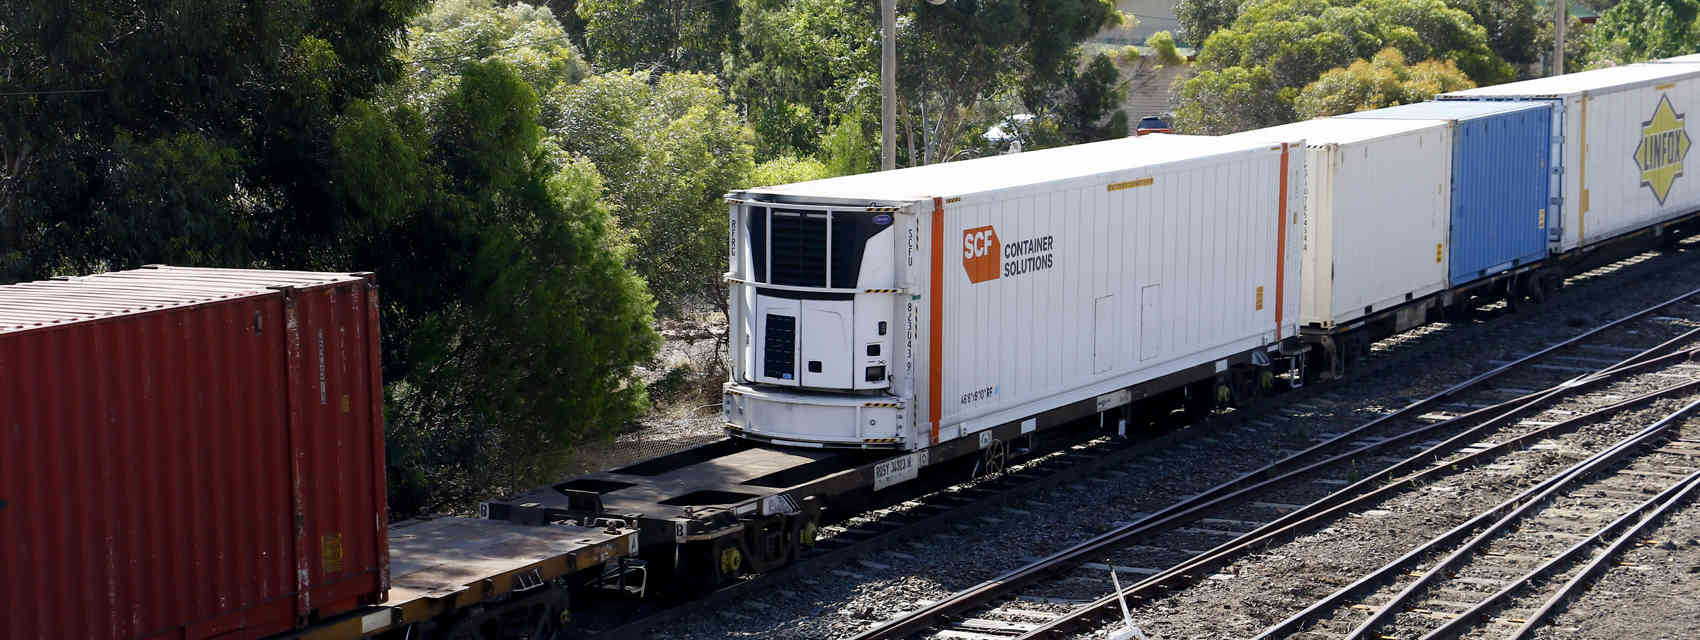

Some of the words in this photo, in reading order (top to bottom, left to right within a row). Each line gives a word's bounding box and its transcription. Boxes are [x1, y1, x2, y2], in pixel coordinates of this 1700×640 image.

[1644, 129, 1682, 171] LINFOX
[964, 230, 993, 259] SCF
[1004, 235, 1054, 259] CONTAINER
[1004, 254, 1053, 277] SOLUTIONS
[676, 523, 684, 537] B
